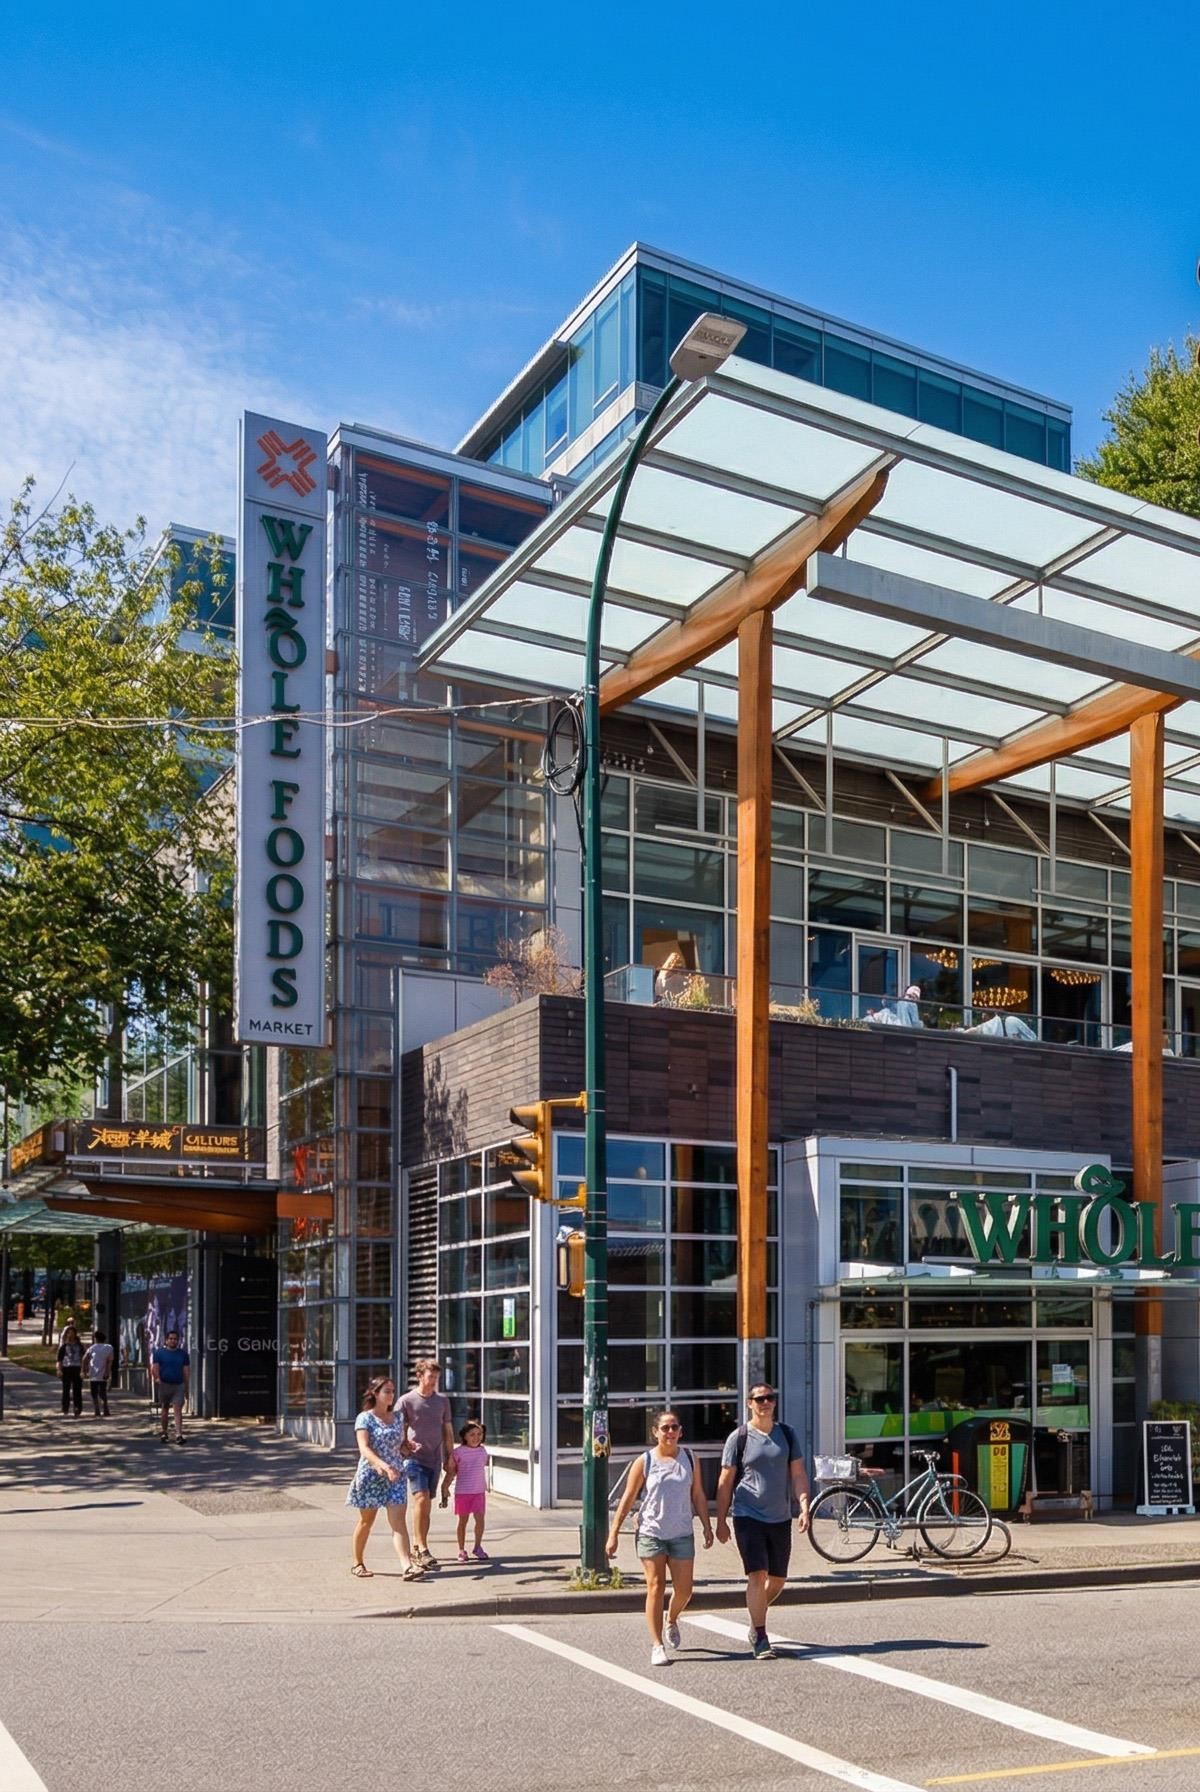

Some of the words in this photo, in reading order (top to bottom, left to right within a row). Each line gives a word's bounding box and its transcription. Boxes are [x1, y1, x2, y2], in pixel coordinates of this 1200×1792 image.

[260, 514, 313, 759] WHOLE
[265, 780, 305, 1008] FOODS
[249, 1018, 314, 1036] MARKET
